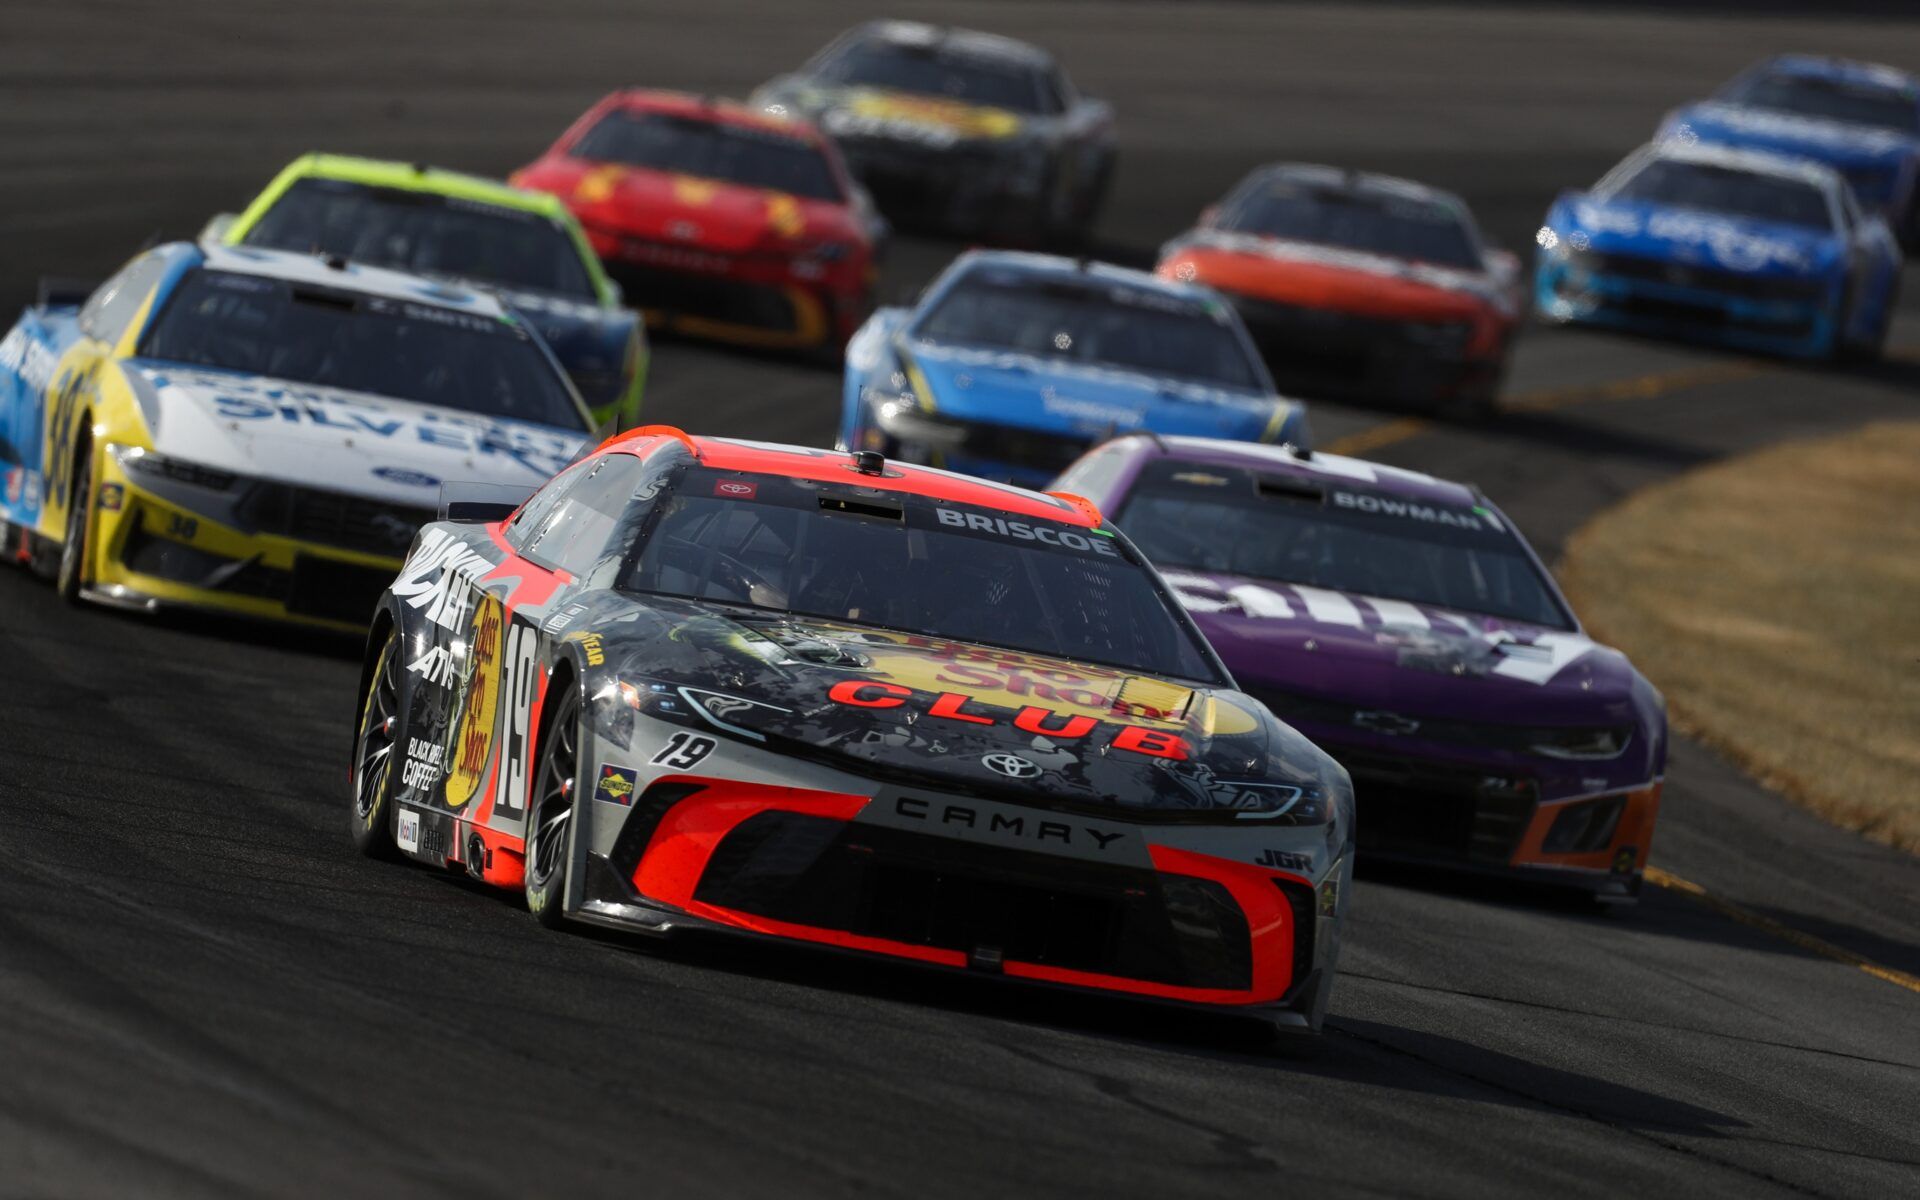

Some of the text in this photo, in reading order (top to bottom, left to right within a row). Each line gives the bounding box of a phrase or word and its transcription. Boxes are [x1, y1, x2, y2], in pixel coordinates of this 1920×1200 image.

[935, 507, 1118, 557] BRISCOE
[1334, 490, 1483, 531] BOWMAN
[406, 645, 455, 691] ATVs
[497, 624, 537, 810] 19
[828, 680, 1192, 761] CLUB
[408, 736, 431, 762] BLACK
[650, 731, 717, 770] 19
[402, 758, 438, 792] COFFEE
[895, 796, 1126, 851] CAMRY
[1255, 848, 1314, 874] JGR
